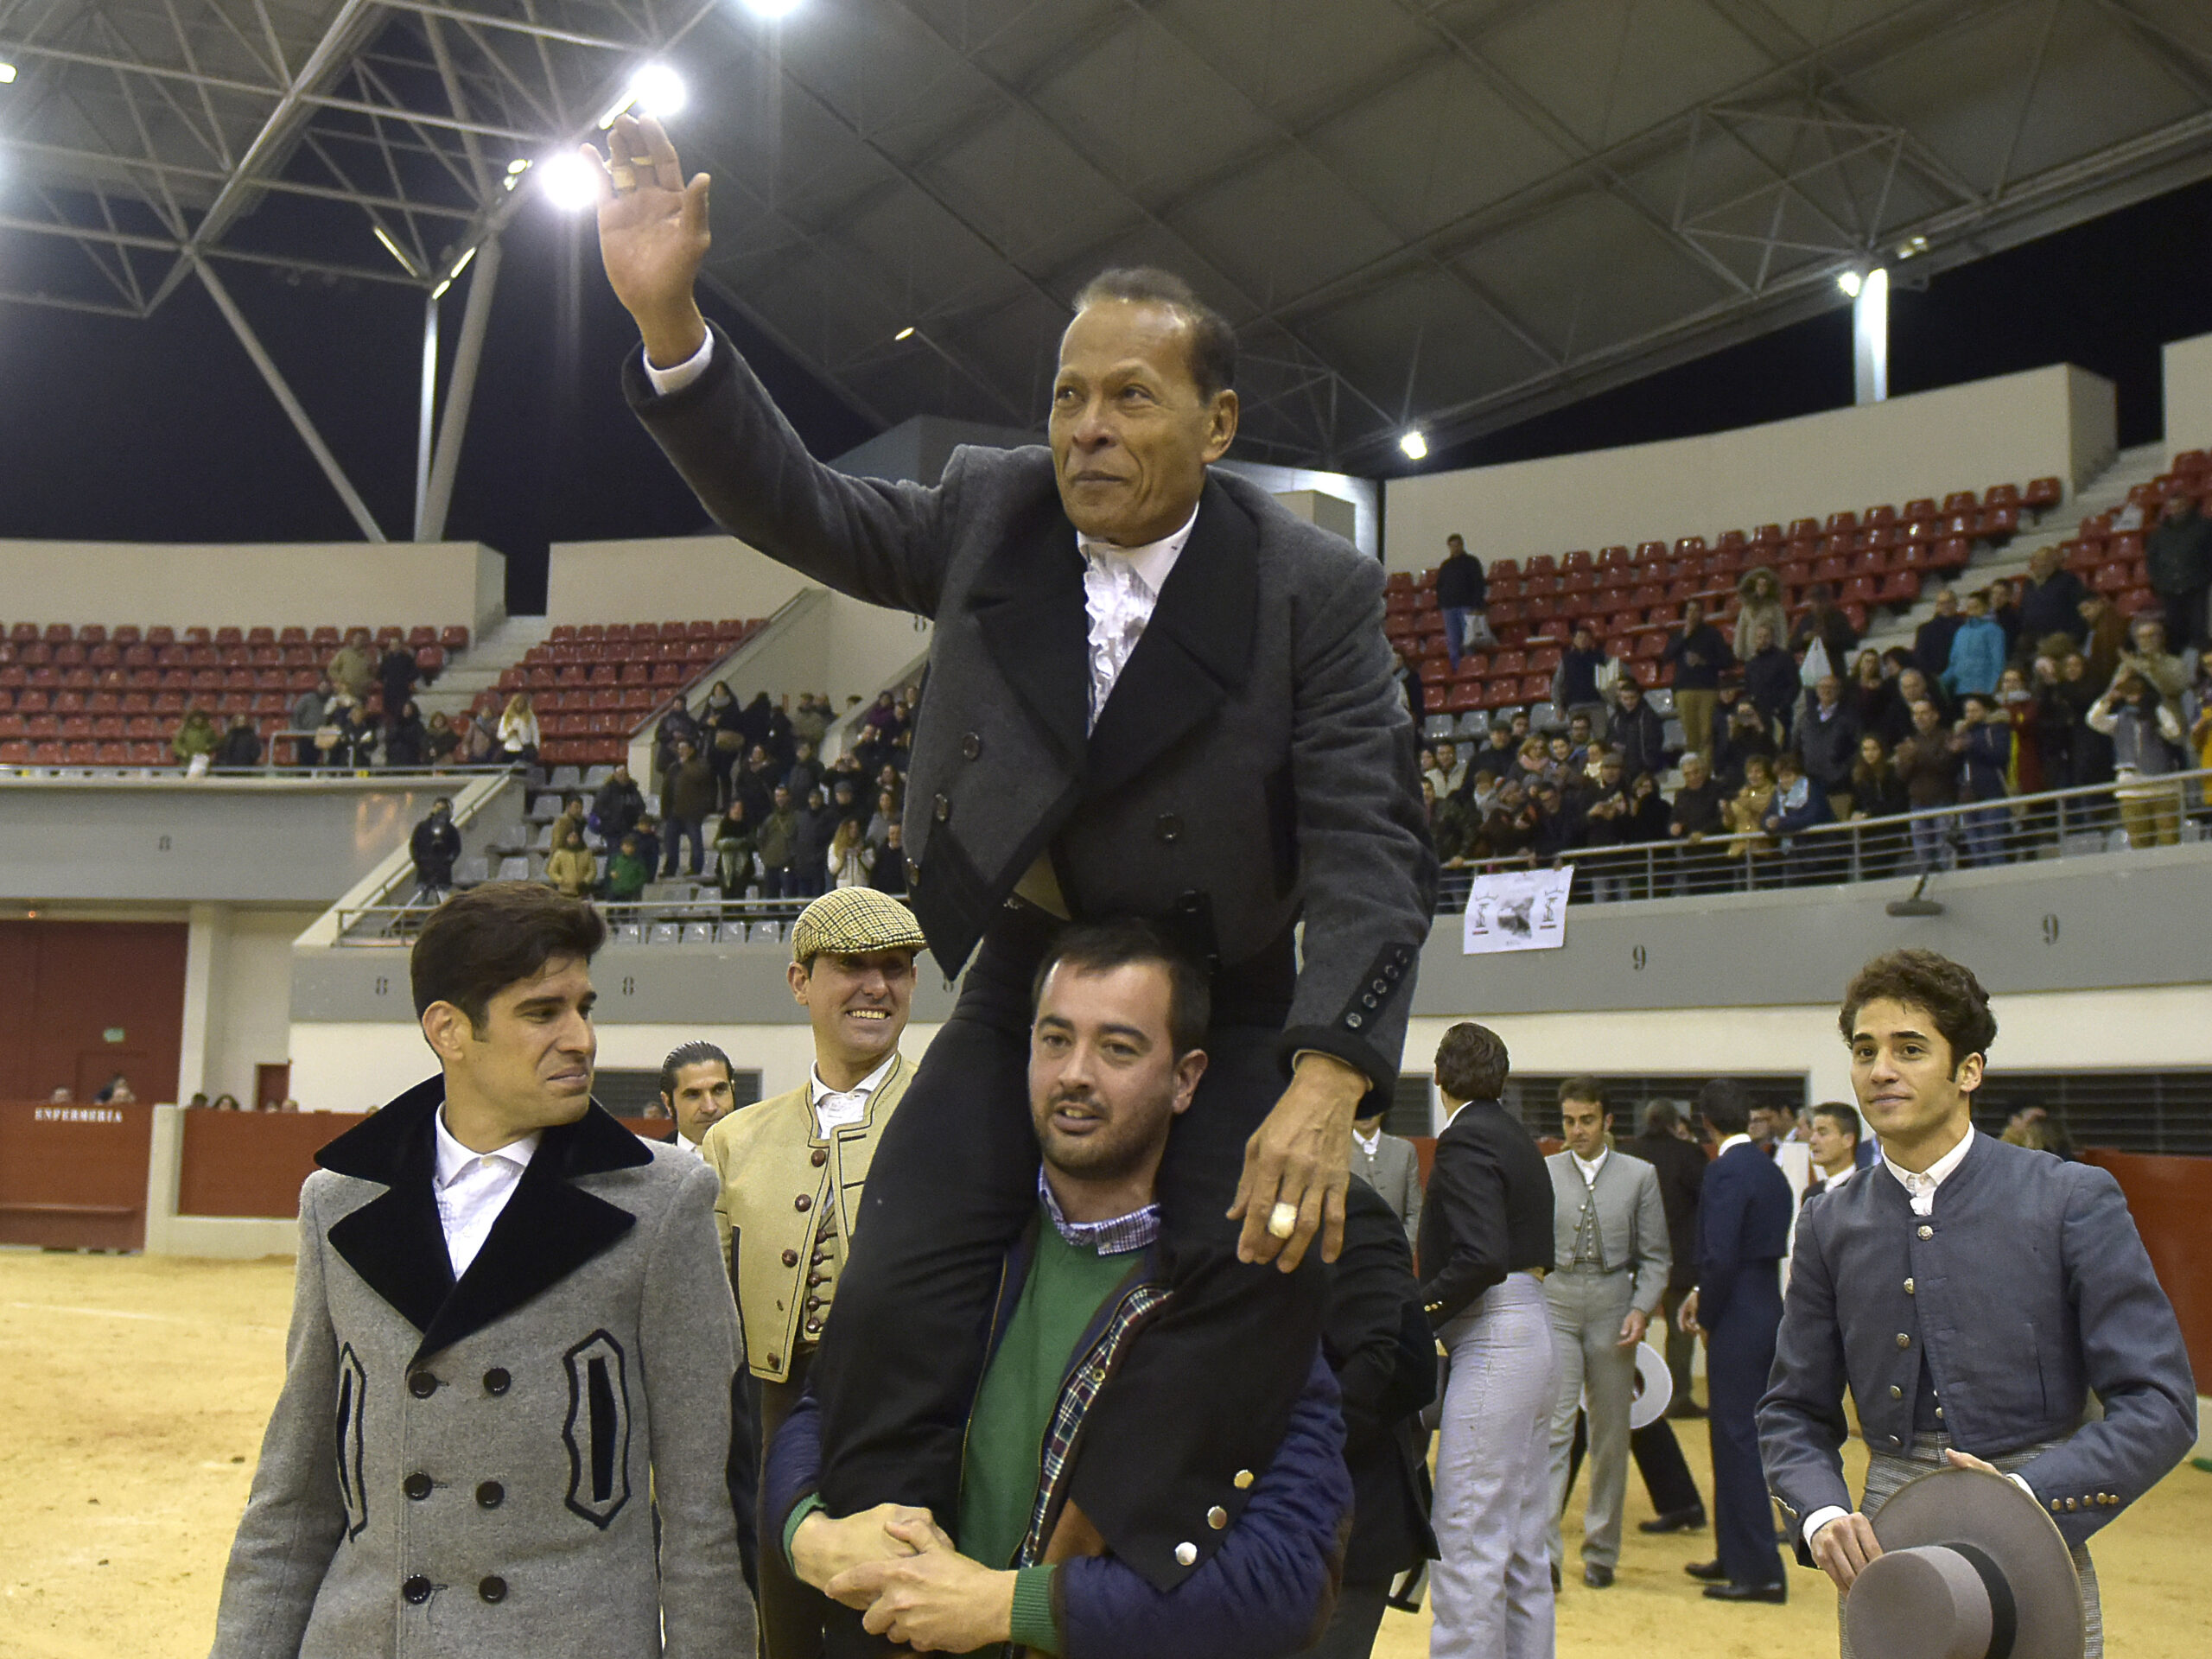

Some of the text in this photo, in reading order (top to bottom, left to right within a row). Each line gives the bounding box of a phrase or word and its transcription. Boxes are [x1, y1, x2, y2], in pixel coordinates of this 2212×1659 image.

[2043, 913, 2058, 945] 9
[1632, 944, 1646, 972] 9
[375, 976, 388, 995] 8
[622, 976, 634, 995] 8
